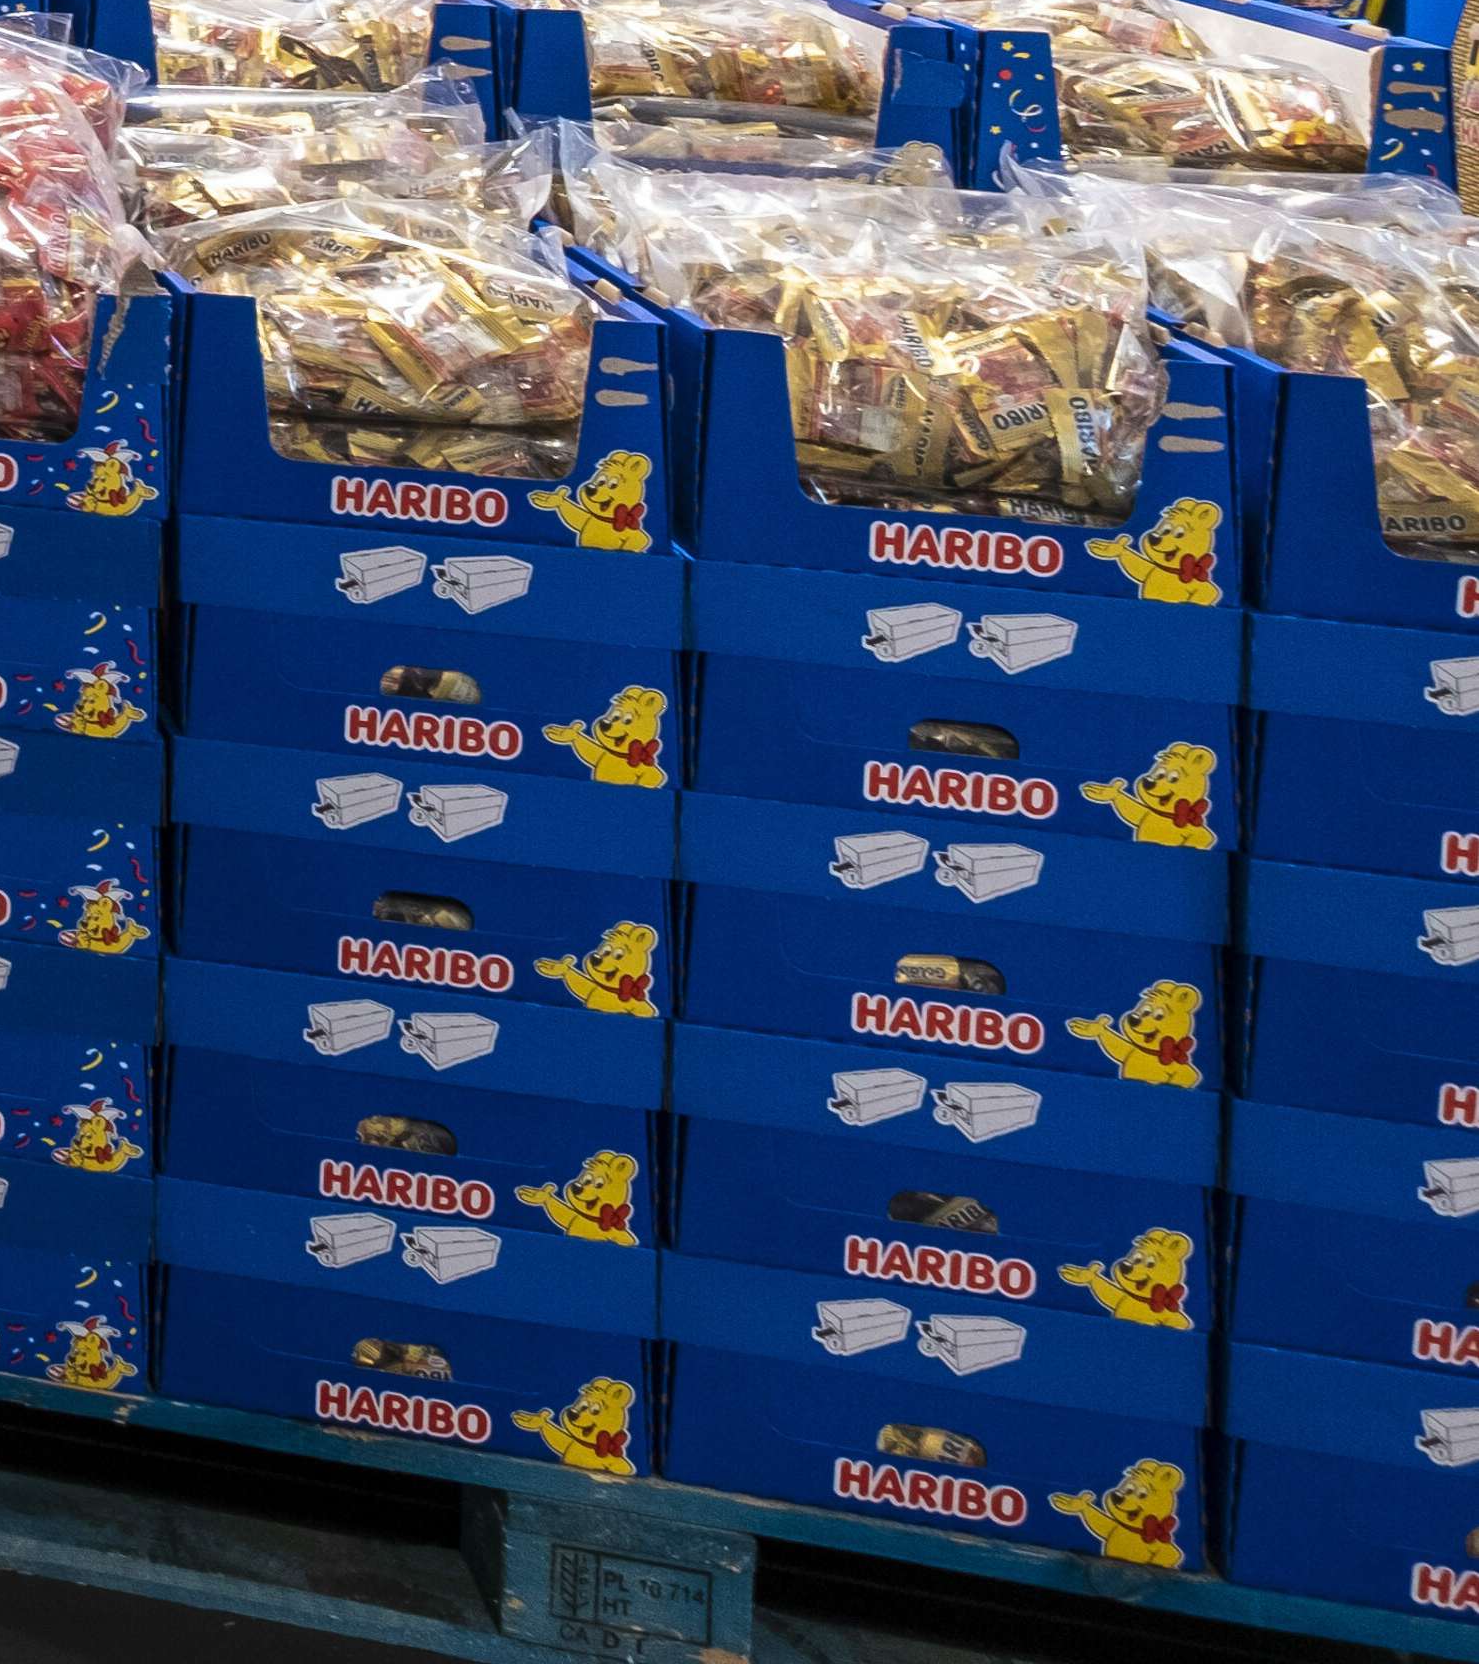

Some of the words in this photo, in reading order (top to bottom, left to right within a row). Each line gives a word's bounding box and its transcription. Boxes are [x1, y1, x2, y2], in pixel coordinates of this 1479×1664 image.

[208, 233, 271, 270] HARIBO
[332, 476, 508, 527] HARIBO
[869, 521, 1065, 578] HARIBO
[343, 705, 523, 758] HARIBO
[850, 992, 1046, 1055] HARIBO
[833, 1456, 1028, 1527] HARIBO
[602, 1569, 630, 1594] PL
[602, 1597, 632, 1617] HT
